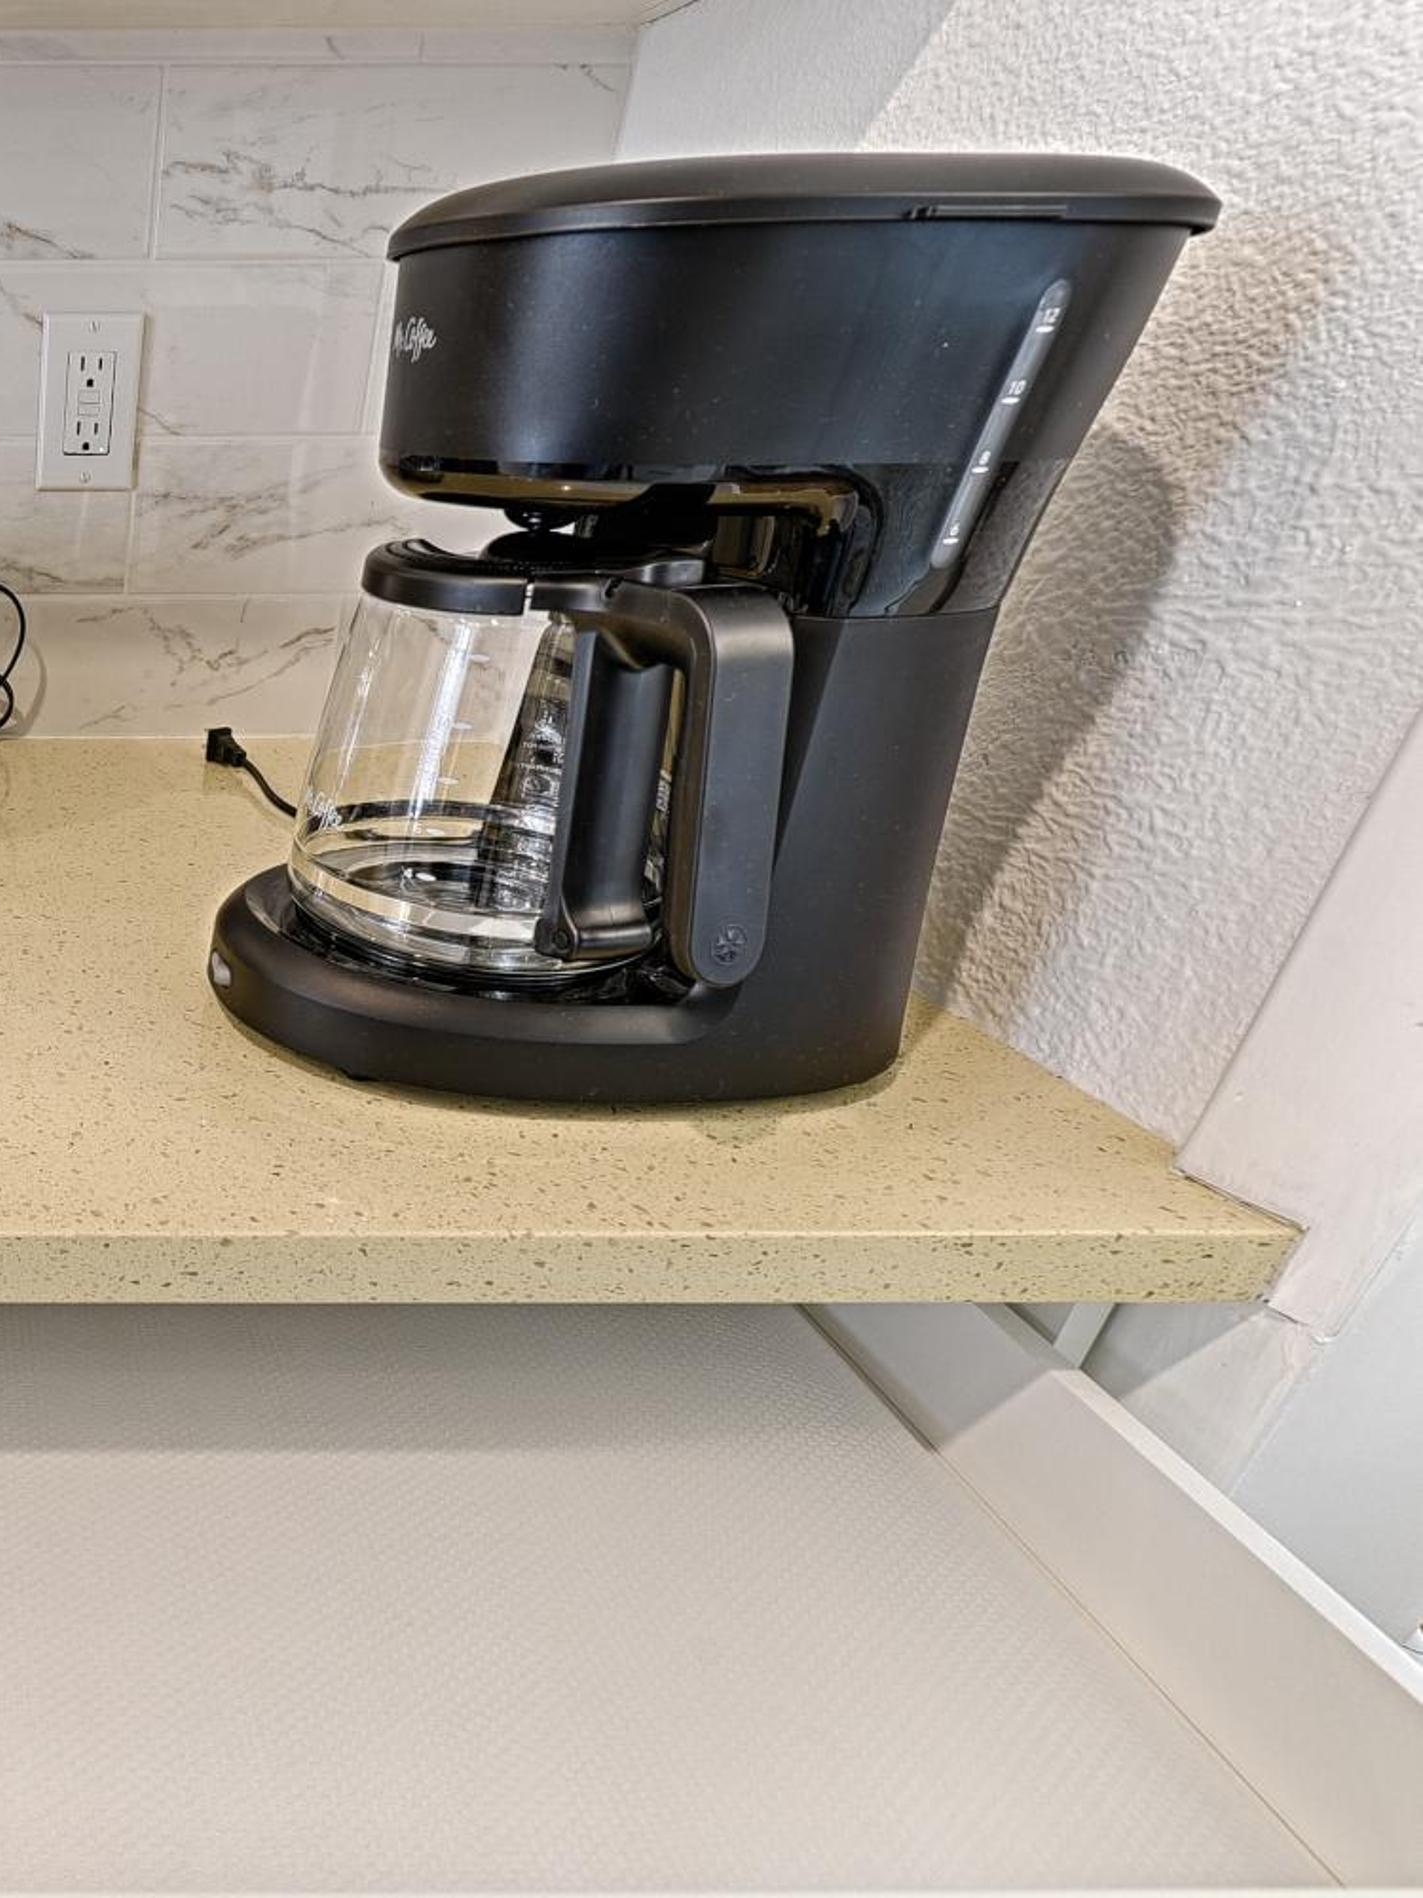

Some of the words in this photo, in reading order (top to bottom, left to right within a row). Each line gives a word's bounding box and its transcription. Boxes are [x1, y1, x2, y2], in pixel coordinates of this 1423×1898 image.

[1042, 307, 1061, 324] 12
[1007, 379, 1027, 396] 10
[978, 450, 991, 466] 8
[949, 523, 960, 537] 6
